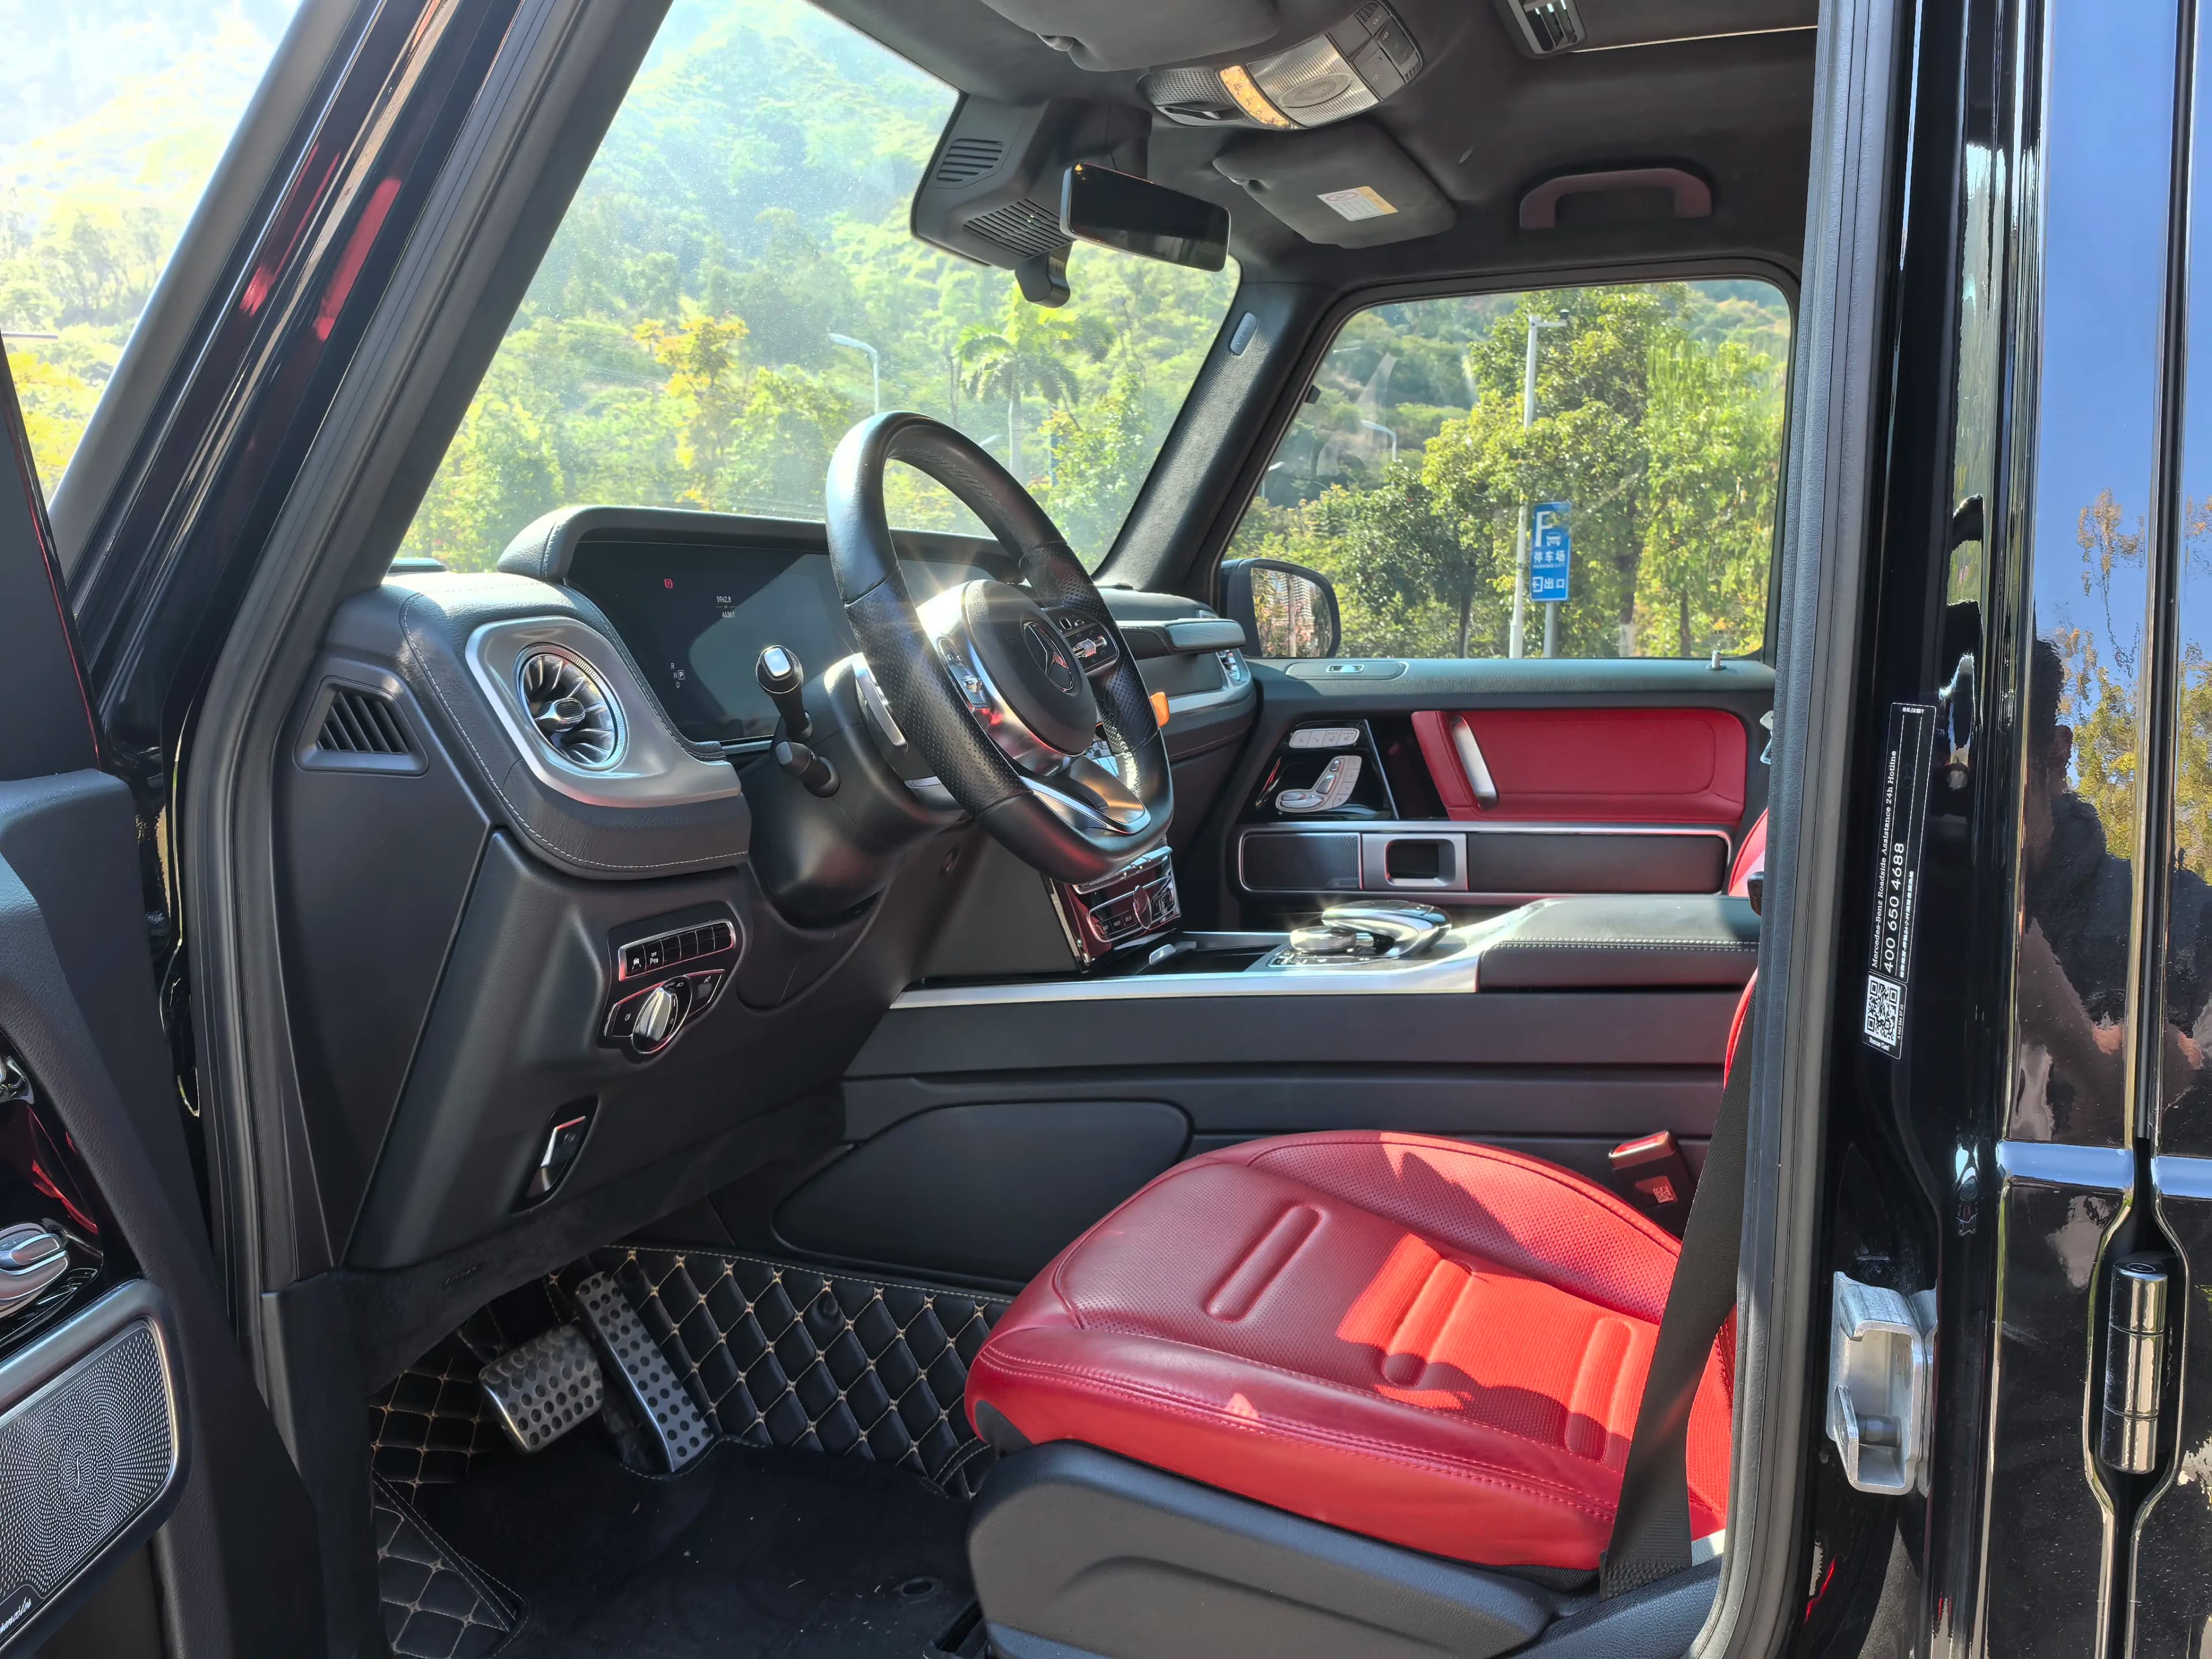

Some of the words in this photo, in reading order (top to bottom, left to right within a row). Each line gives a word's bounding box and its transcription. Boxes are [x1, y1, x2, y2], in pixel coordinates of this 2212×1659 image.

[1544, 578, 1565, 589] 出口
[1887, 751, 1896, 785] Hotline
[1885, 786, 1893, 805] 24h
[1881, 806, 1891, 856] Assistance
[1877, 858, 1887, 899] Roadside
[1892, 842, 1904, 890] 4688
[1888, 896, 1899, 931] 650
[1872, 900, 1883, 968] Mercedes-Benz
[1884, 937, 1896, 974] 400
